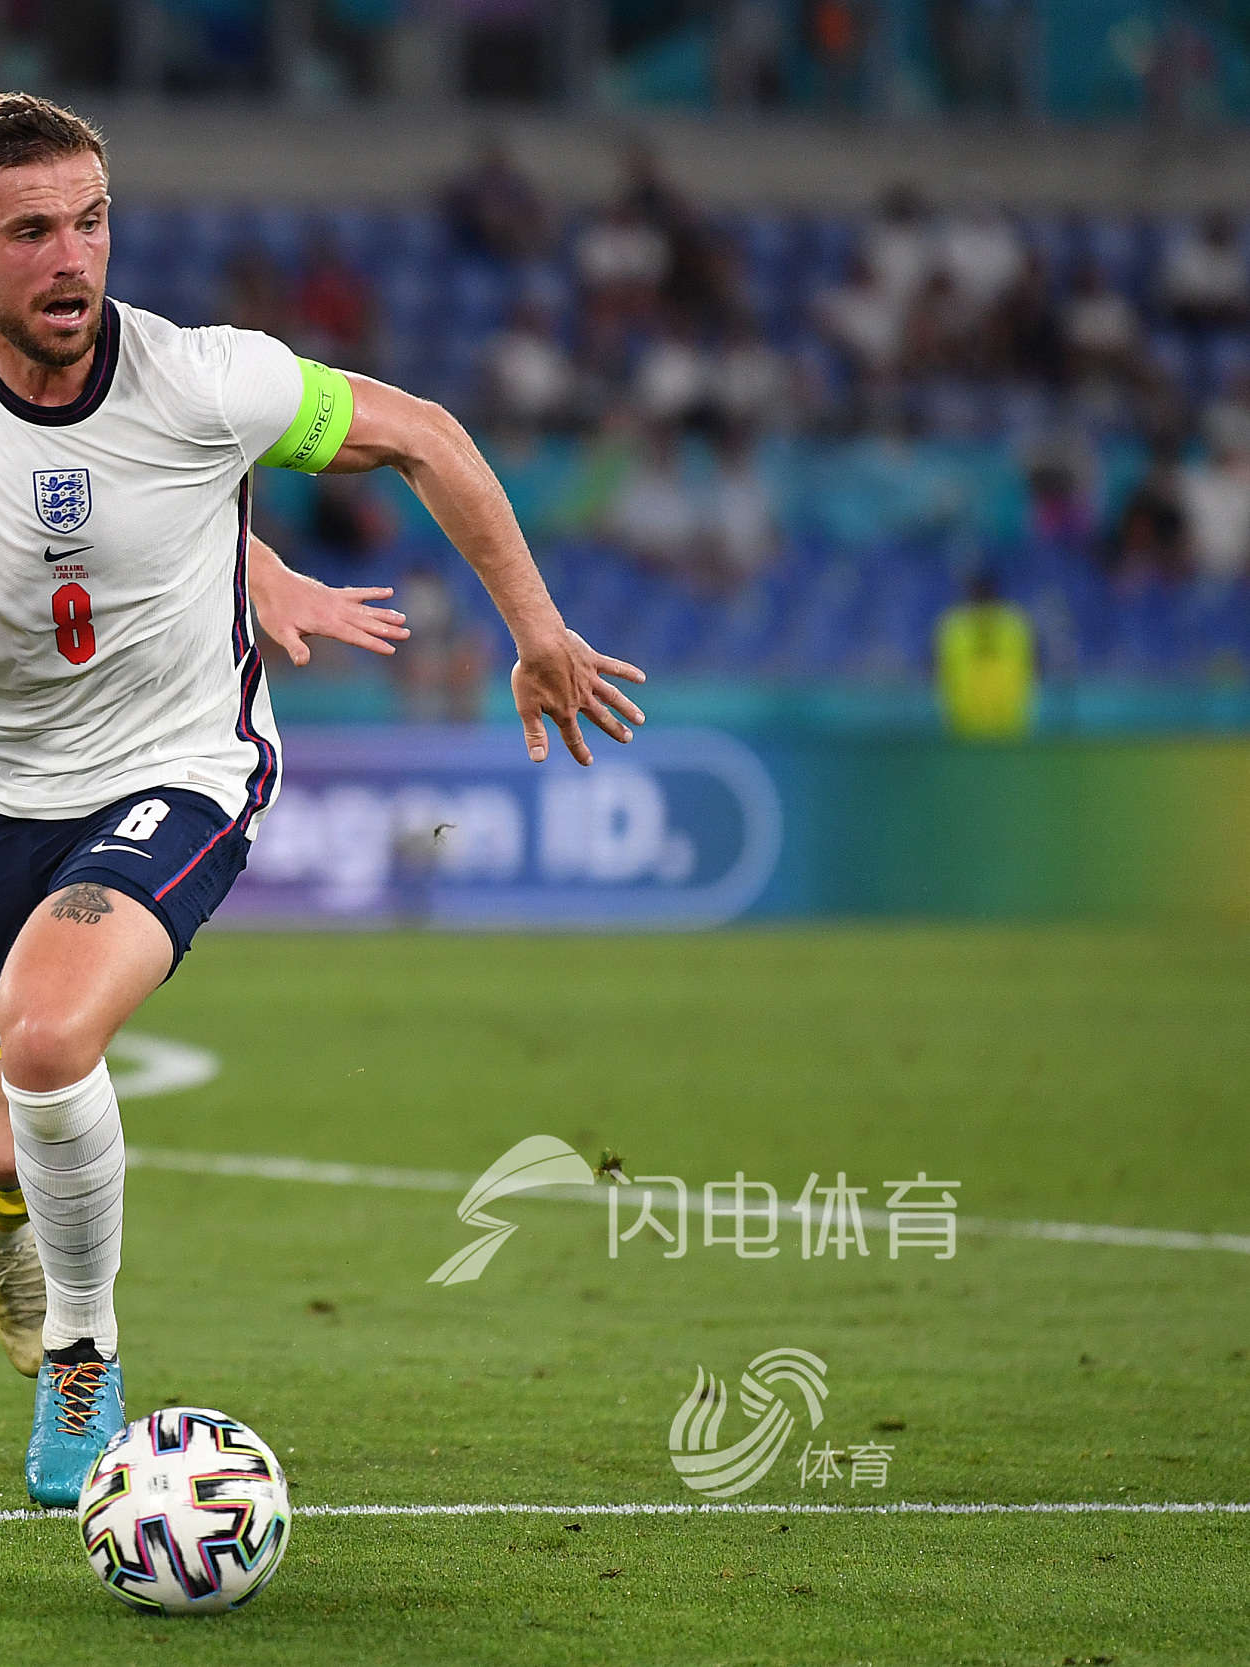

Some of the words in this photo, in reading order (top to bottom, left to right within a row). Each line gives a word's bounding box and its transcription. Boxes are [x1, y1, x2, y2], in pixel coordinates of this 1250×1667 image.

[295, 388, 331, 460] RESPECT
[53, 582, 95, 665] 8
[113, 799, 170, 841] 8
